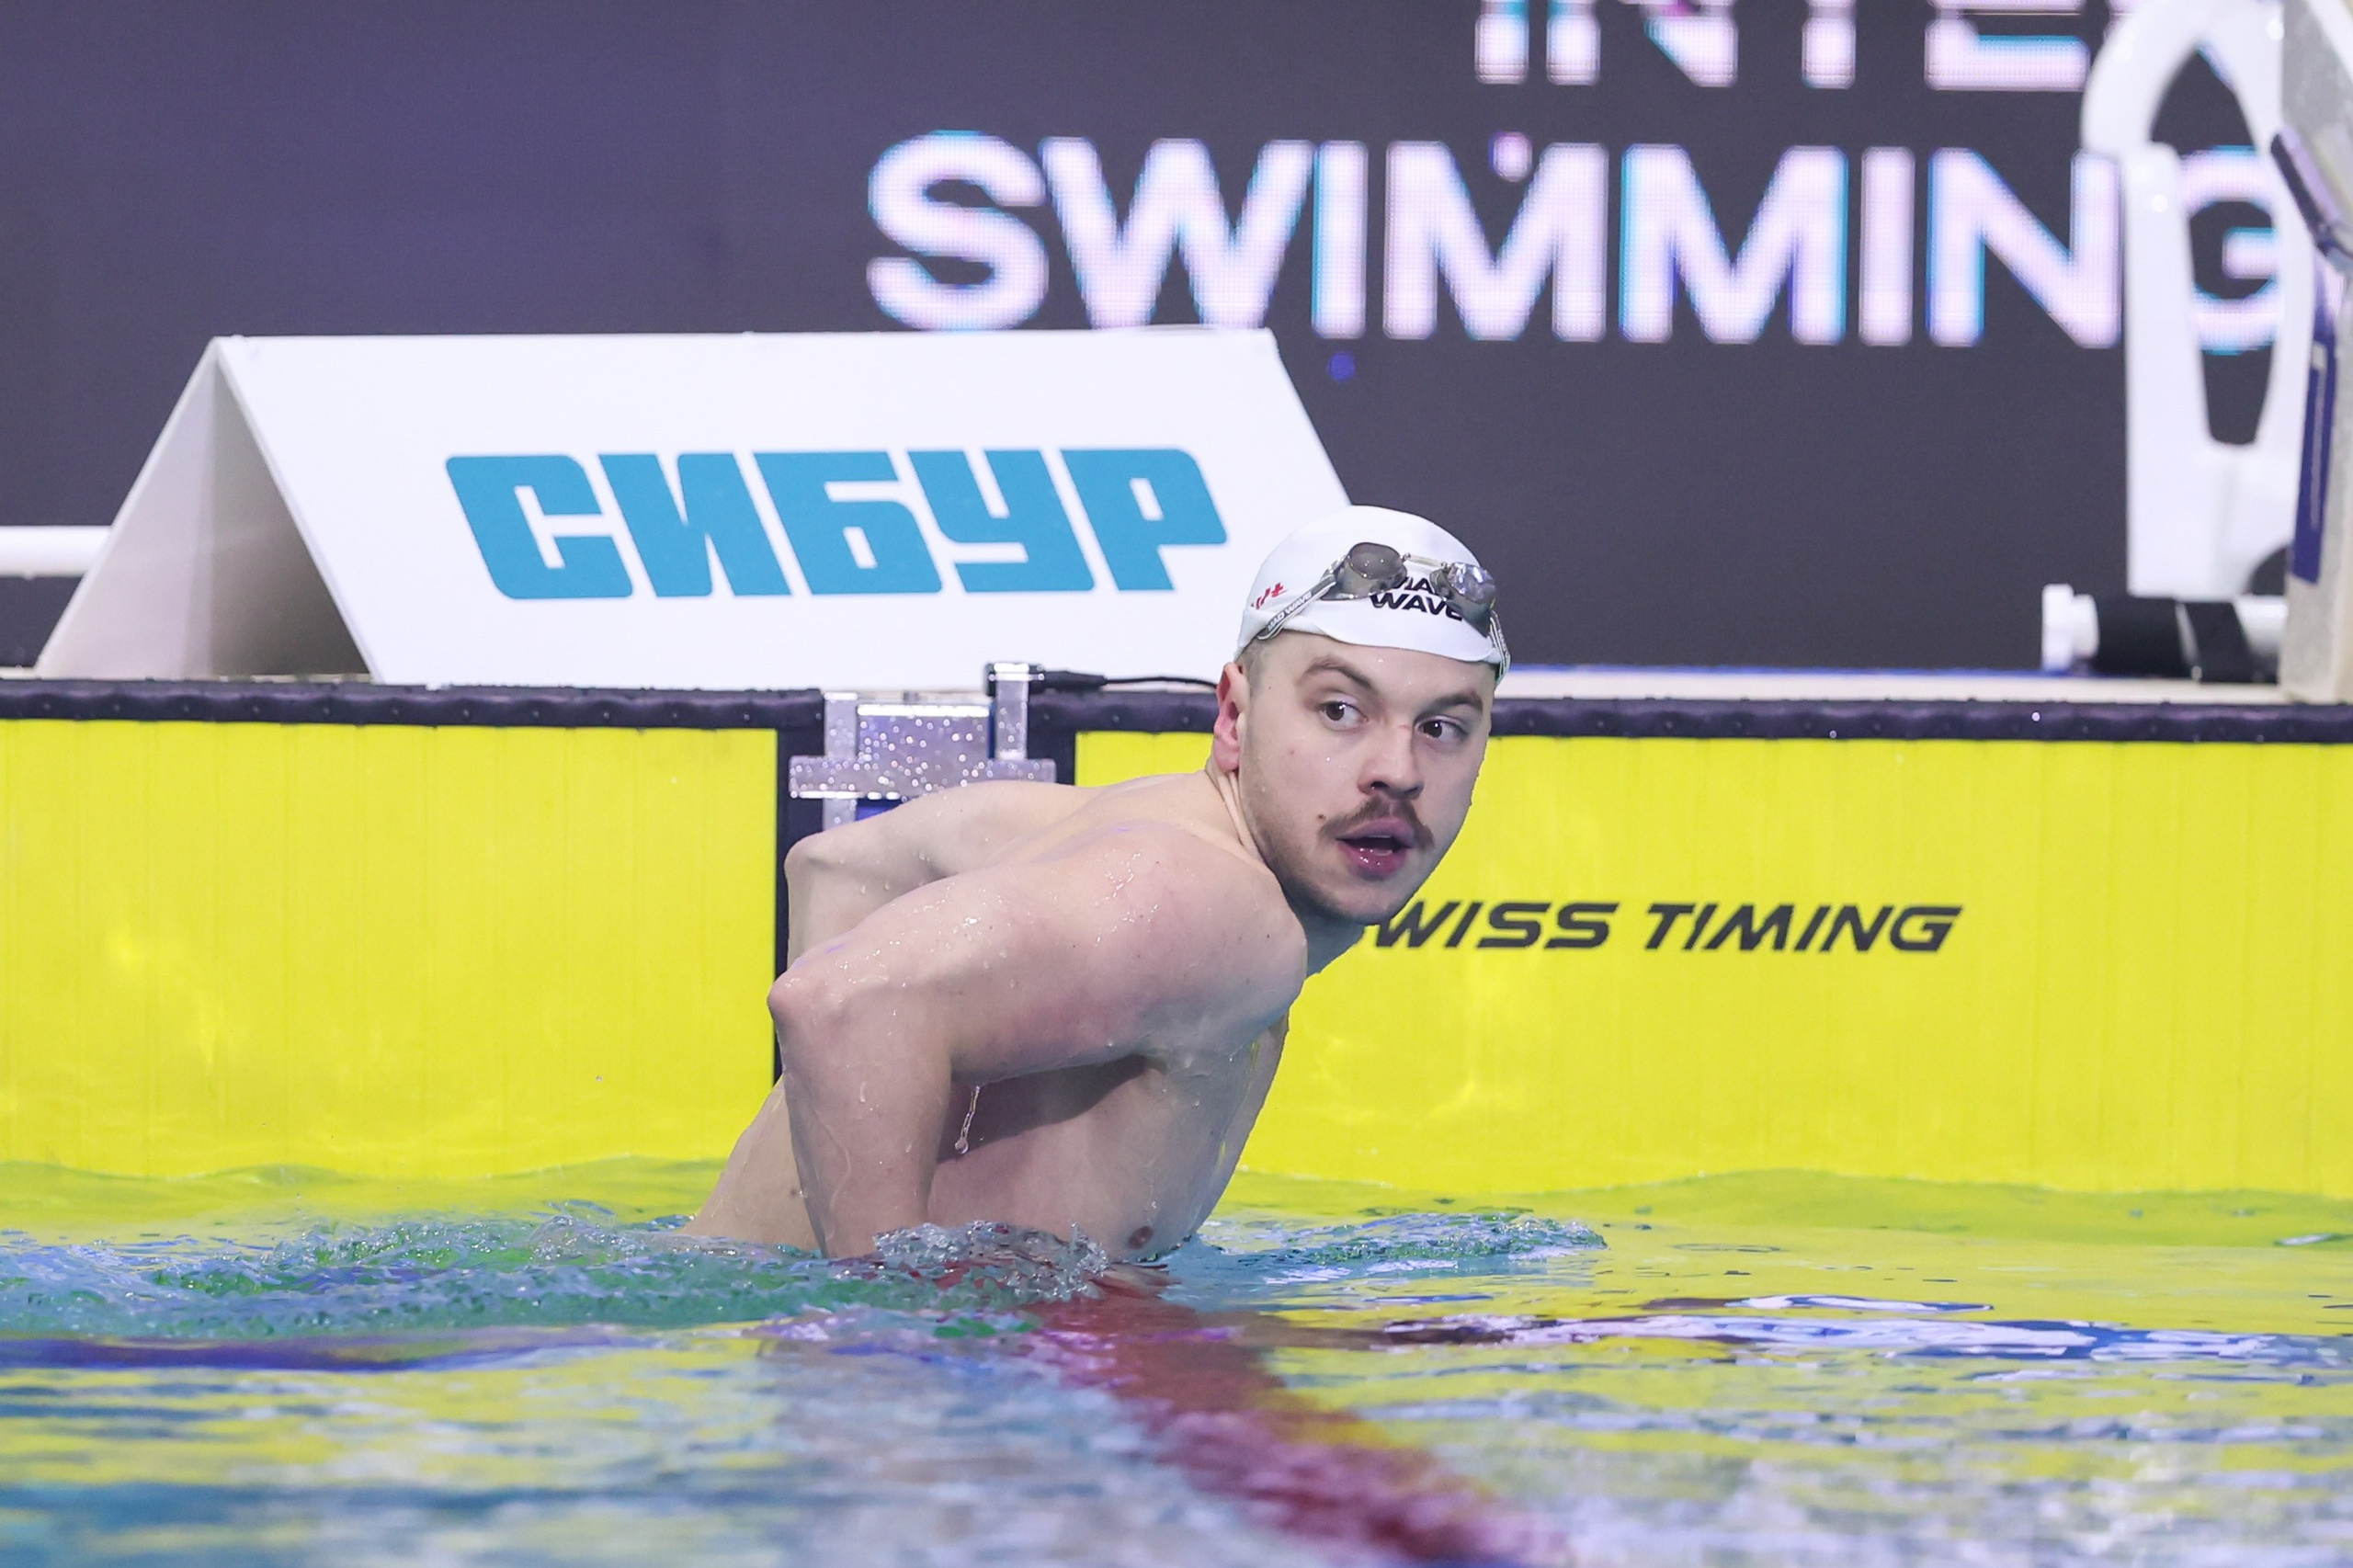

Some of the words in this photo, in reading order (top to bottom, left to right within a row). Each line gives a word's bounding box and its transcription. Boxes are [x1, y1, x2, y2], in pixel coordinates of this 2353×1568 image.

[446, 448, 1227, 600] СИБУР
[1285, 591, 1313, 615] WAVE
[1376, 901, 1620, 949] WISS
[1644, 903, 1963, 952] TIMING
